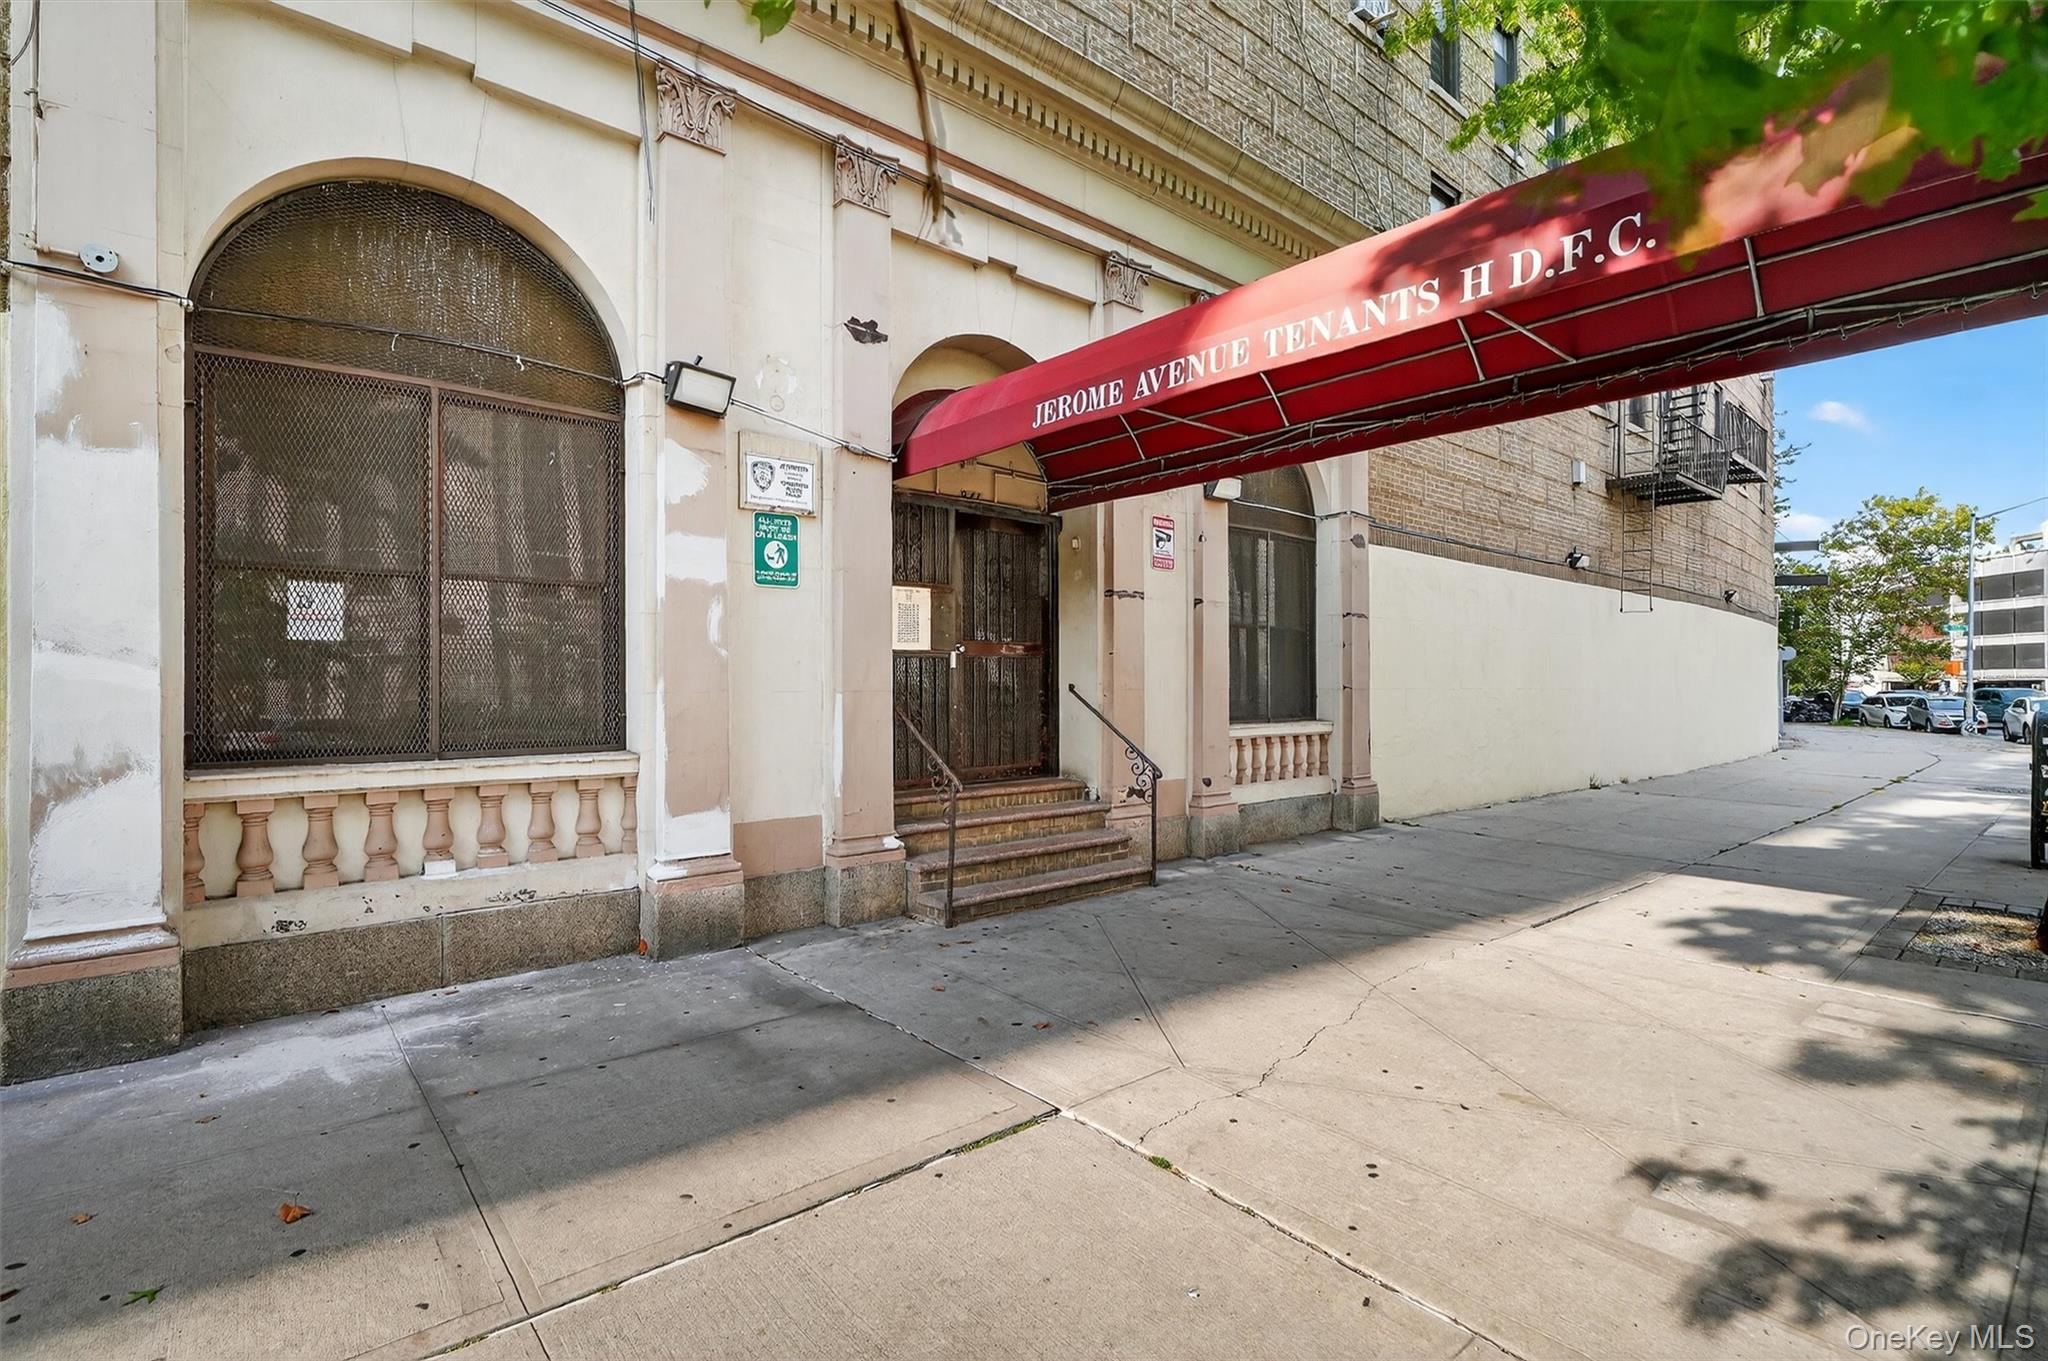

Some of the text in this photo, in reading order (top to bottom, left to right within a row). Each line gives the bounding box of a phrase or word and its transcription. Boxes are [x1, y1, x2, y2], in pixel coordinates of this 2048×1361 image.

[1032, 212, 1657, 428] JEROME AVENUE TENANTS H D.F.C.
